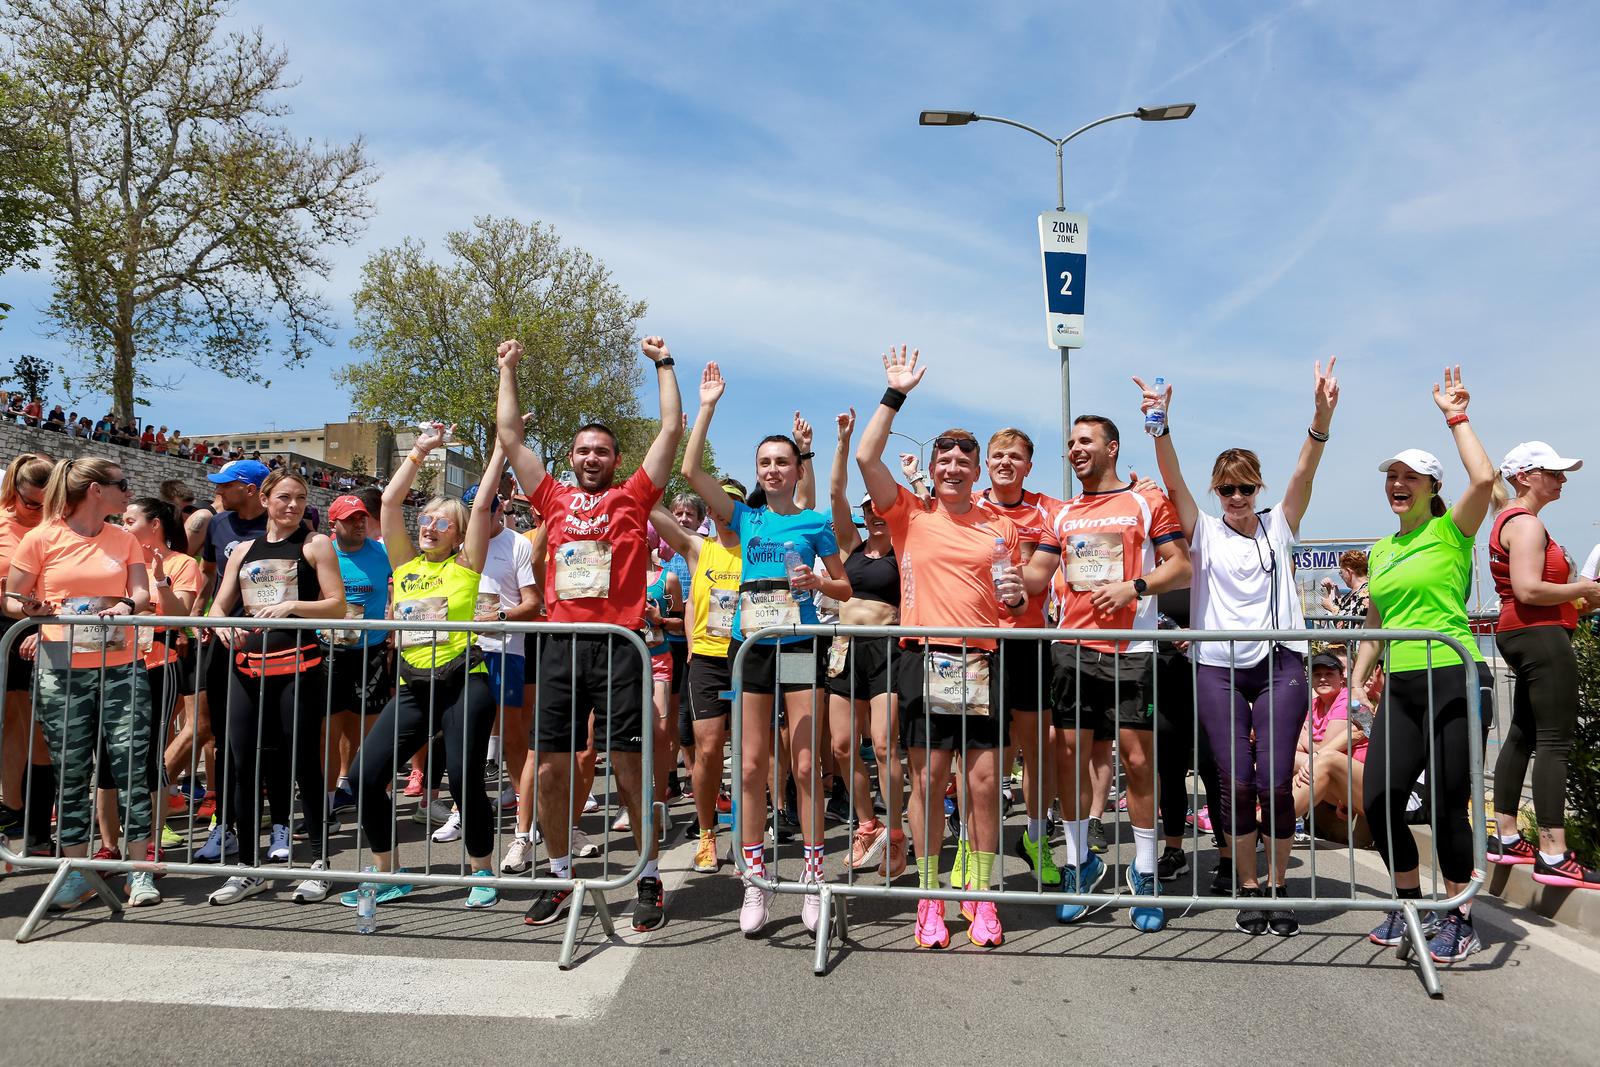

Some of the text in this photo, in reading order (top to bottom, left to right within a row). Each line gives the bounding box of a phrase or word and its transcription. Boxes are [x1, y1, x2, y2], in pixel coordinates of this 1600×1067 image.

[1052, 221, 1079, 234] ZONA
[1056, 234, 1075, 243] ZONE
[1060, 271, 1073, 296] 2
[1063, 516, 1138, 532] GWmoves
[752, 552, 785, 563] WORLD
[1080, 549, 1112, 558] WORLD RUN
[1079, 564, 1103, 574] 50707
[255, 575, 274, 583] WORLD
[754, 594, 788, 603] WORLD RUN
[755, 609, 779, 618] 50141
